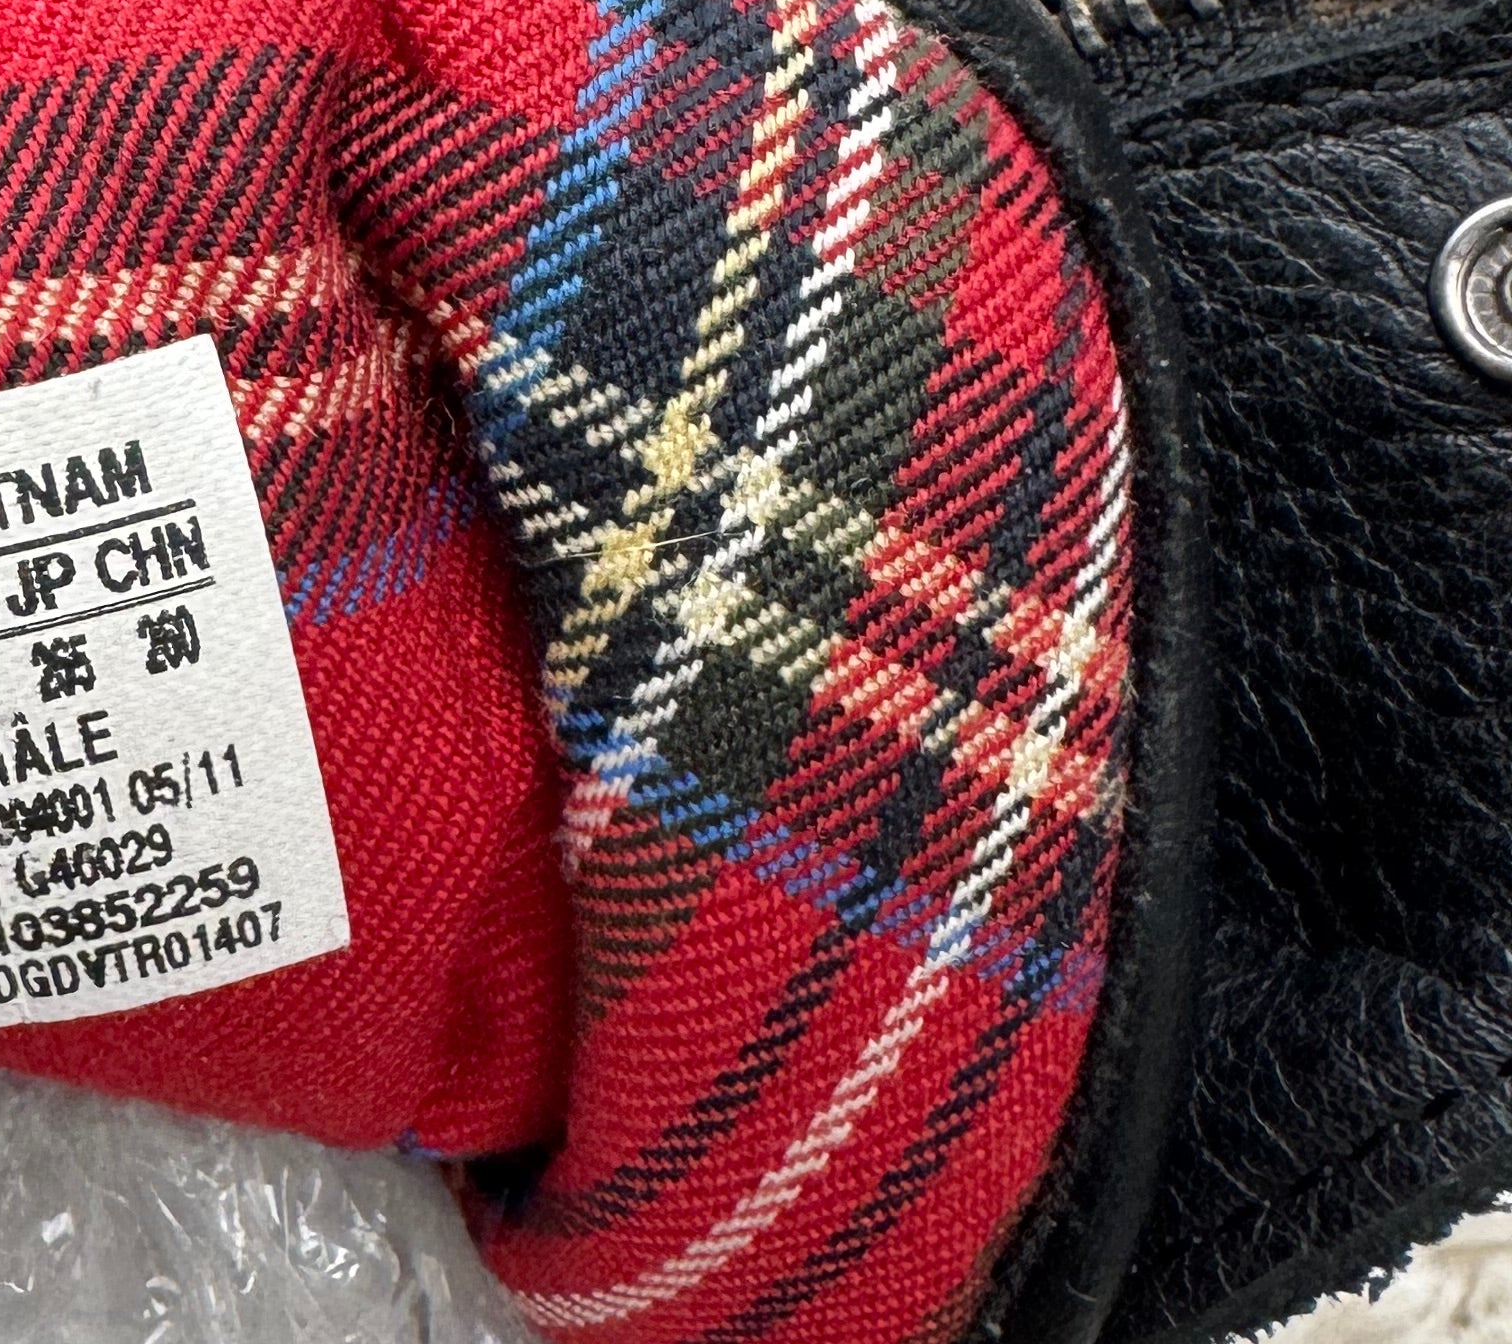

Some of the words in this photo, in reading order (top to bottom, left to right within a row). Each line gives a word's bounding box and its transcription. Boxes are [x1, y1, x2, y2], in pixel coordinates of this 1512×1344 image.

[6, 552, 76, 616] JP
[95, 516, 211, 593] CHN
[128, 743, 244, 816] 05/11
